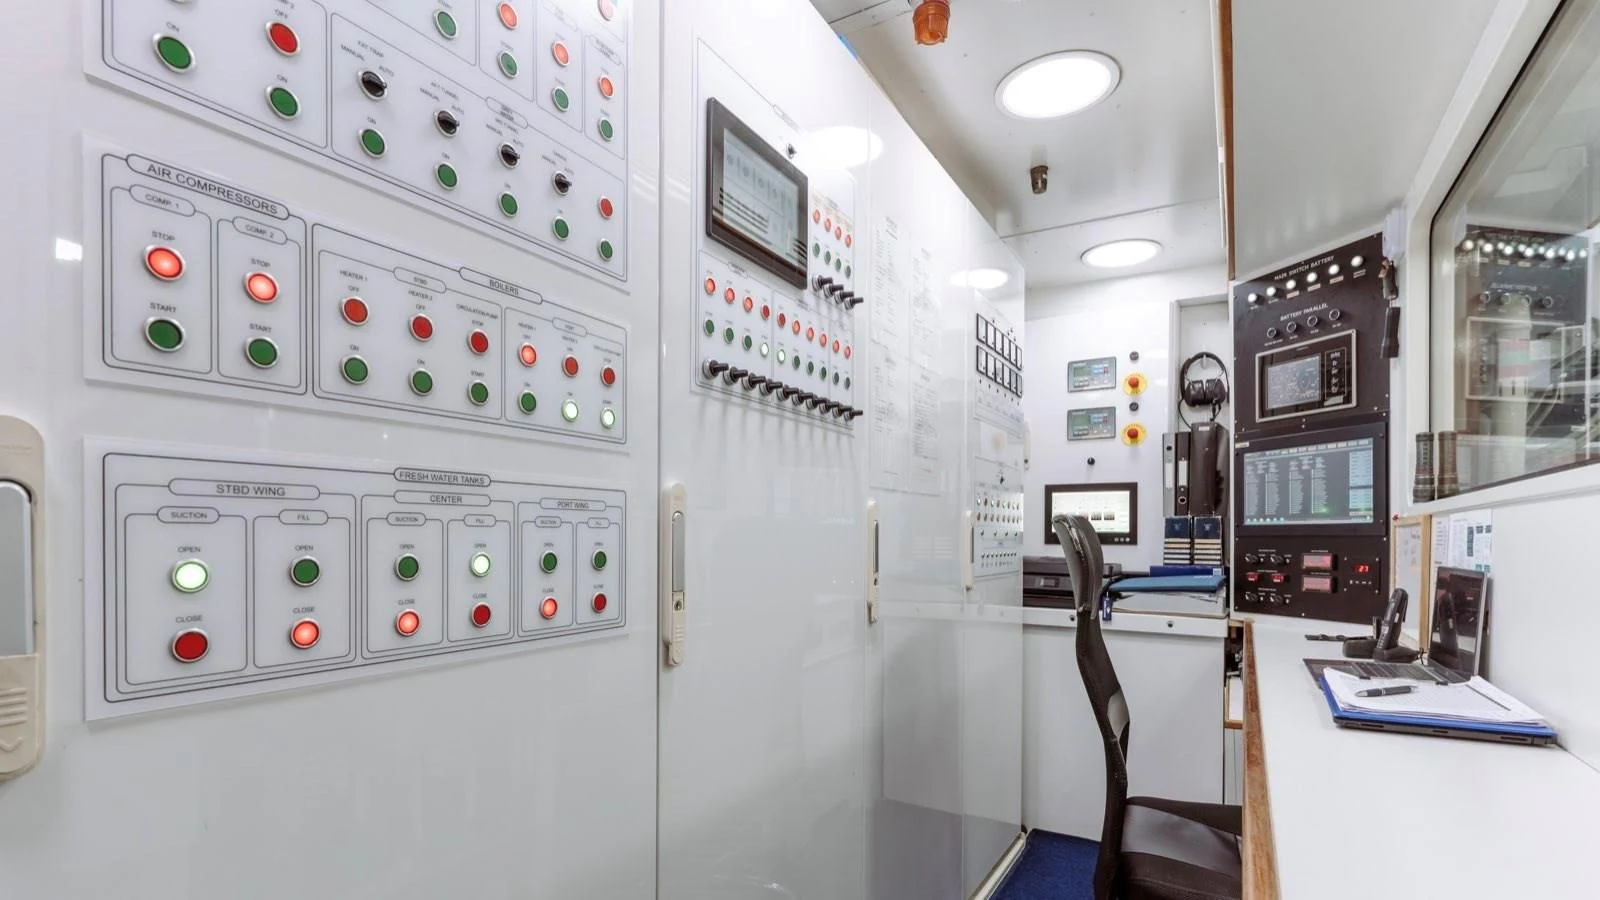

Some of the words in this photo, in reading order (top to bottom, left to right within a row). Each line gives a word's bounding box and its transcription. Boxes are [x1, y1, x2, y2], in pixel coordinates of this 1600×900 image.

[165, 21, 180, 32] ON
[340, 44, 364, 61] MANUAL
[378, 65, 394, 76] AUTO
[276, 74, 288, 84] ON
[451, 105, 464, 115] AUTO
[366, 116, 376, 124] ON
[441, 151, 450, 159] ON
[147, 163, 172, 179] AIR
[175, 171, 278, 215] COMPRESSORS
[151, 229, 176, 241] STOP
[250, 258, 270, 268] STOP
[1274, 272, 1288, 280] MAIN
[1288, 264, 1310, 276] SWITCH
[1310, 255, 1334, 268] BATTERY
[339, 269, 364, 281] HEATER
[347, 285, 360, 293] OFF
[489, 279, 520, 296] BOILERS
[407, 289, 428, 300] HEATER
[149, 302, 176, 314] START
[415, 303, 426, 311] OFF
[1280, 310, 1302, 321] BATTERY
[1302, 302, 1328, 314] PARALLEL
[249, 322, 272, 334] START
[349, 343, 360, 351] ON
[398, 470, 430, 481] FRESH
[430, 473, 460, 483] WATER
[460, 476, 486, 486] TANKS
[215, 483, 250, 496] STBD
[252, 484, 286, 497] WING
[429, 494, 462, 504] CENTER
[557, 500, 572, 508] PORT
[170, 510, 208, 520] SUCTION
[297, 513, 310, 521] FILL
[394, 515, 418, 523] SUCTION
[177, 545, 202, 553] OPEN
[471, 592, 488, 600] CLOSE
[397, 598, 416, 606] CLOSE
[292, 605, 316, 615] CLOSE
[176, 614, 204, 624] CLOSE
